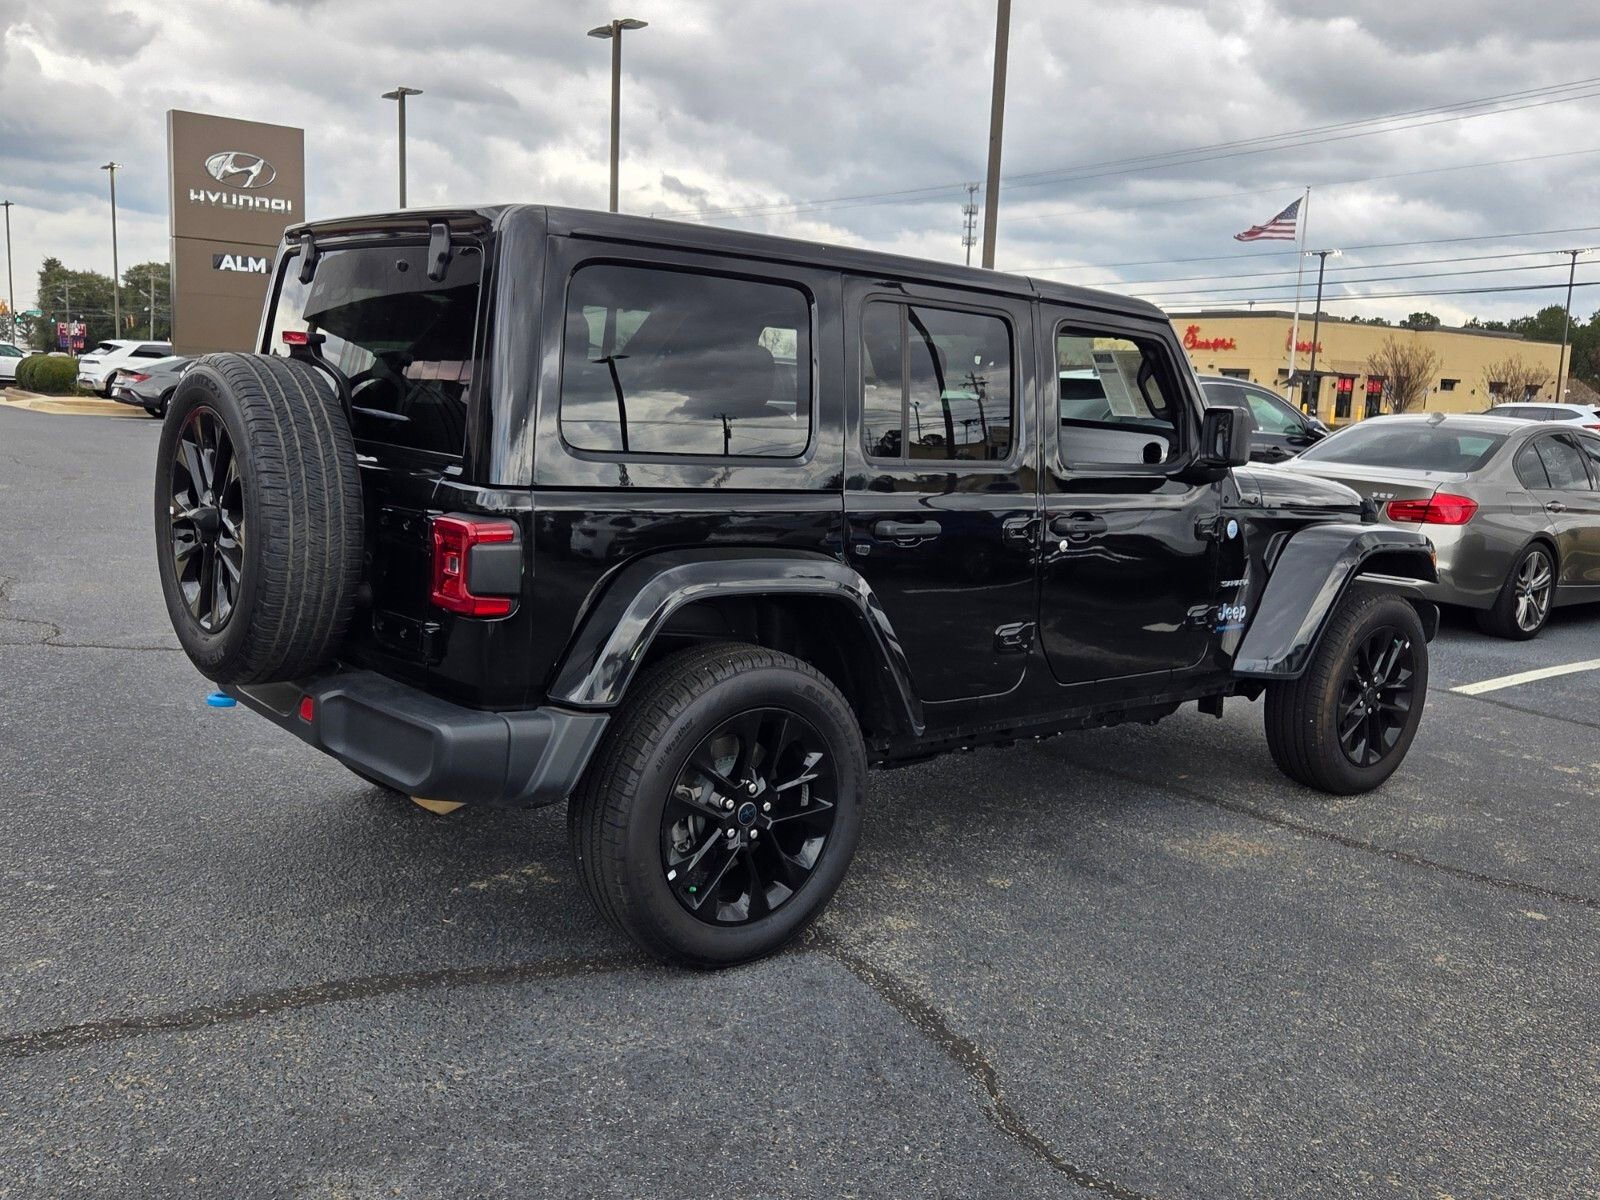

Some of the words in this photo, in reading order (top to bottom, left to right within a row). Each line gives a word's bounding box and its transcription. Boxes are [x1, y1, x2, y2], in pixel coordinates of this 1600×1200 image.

[189, 188, 292, 212] HYUNDAI
[219, 254, 267, 274] ALM
[1217, 602, 1247, 622] Jeep
